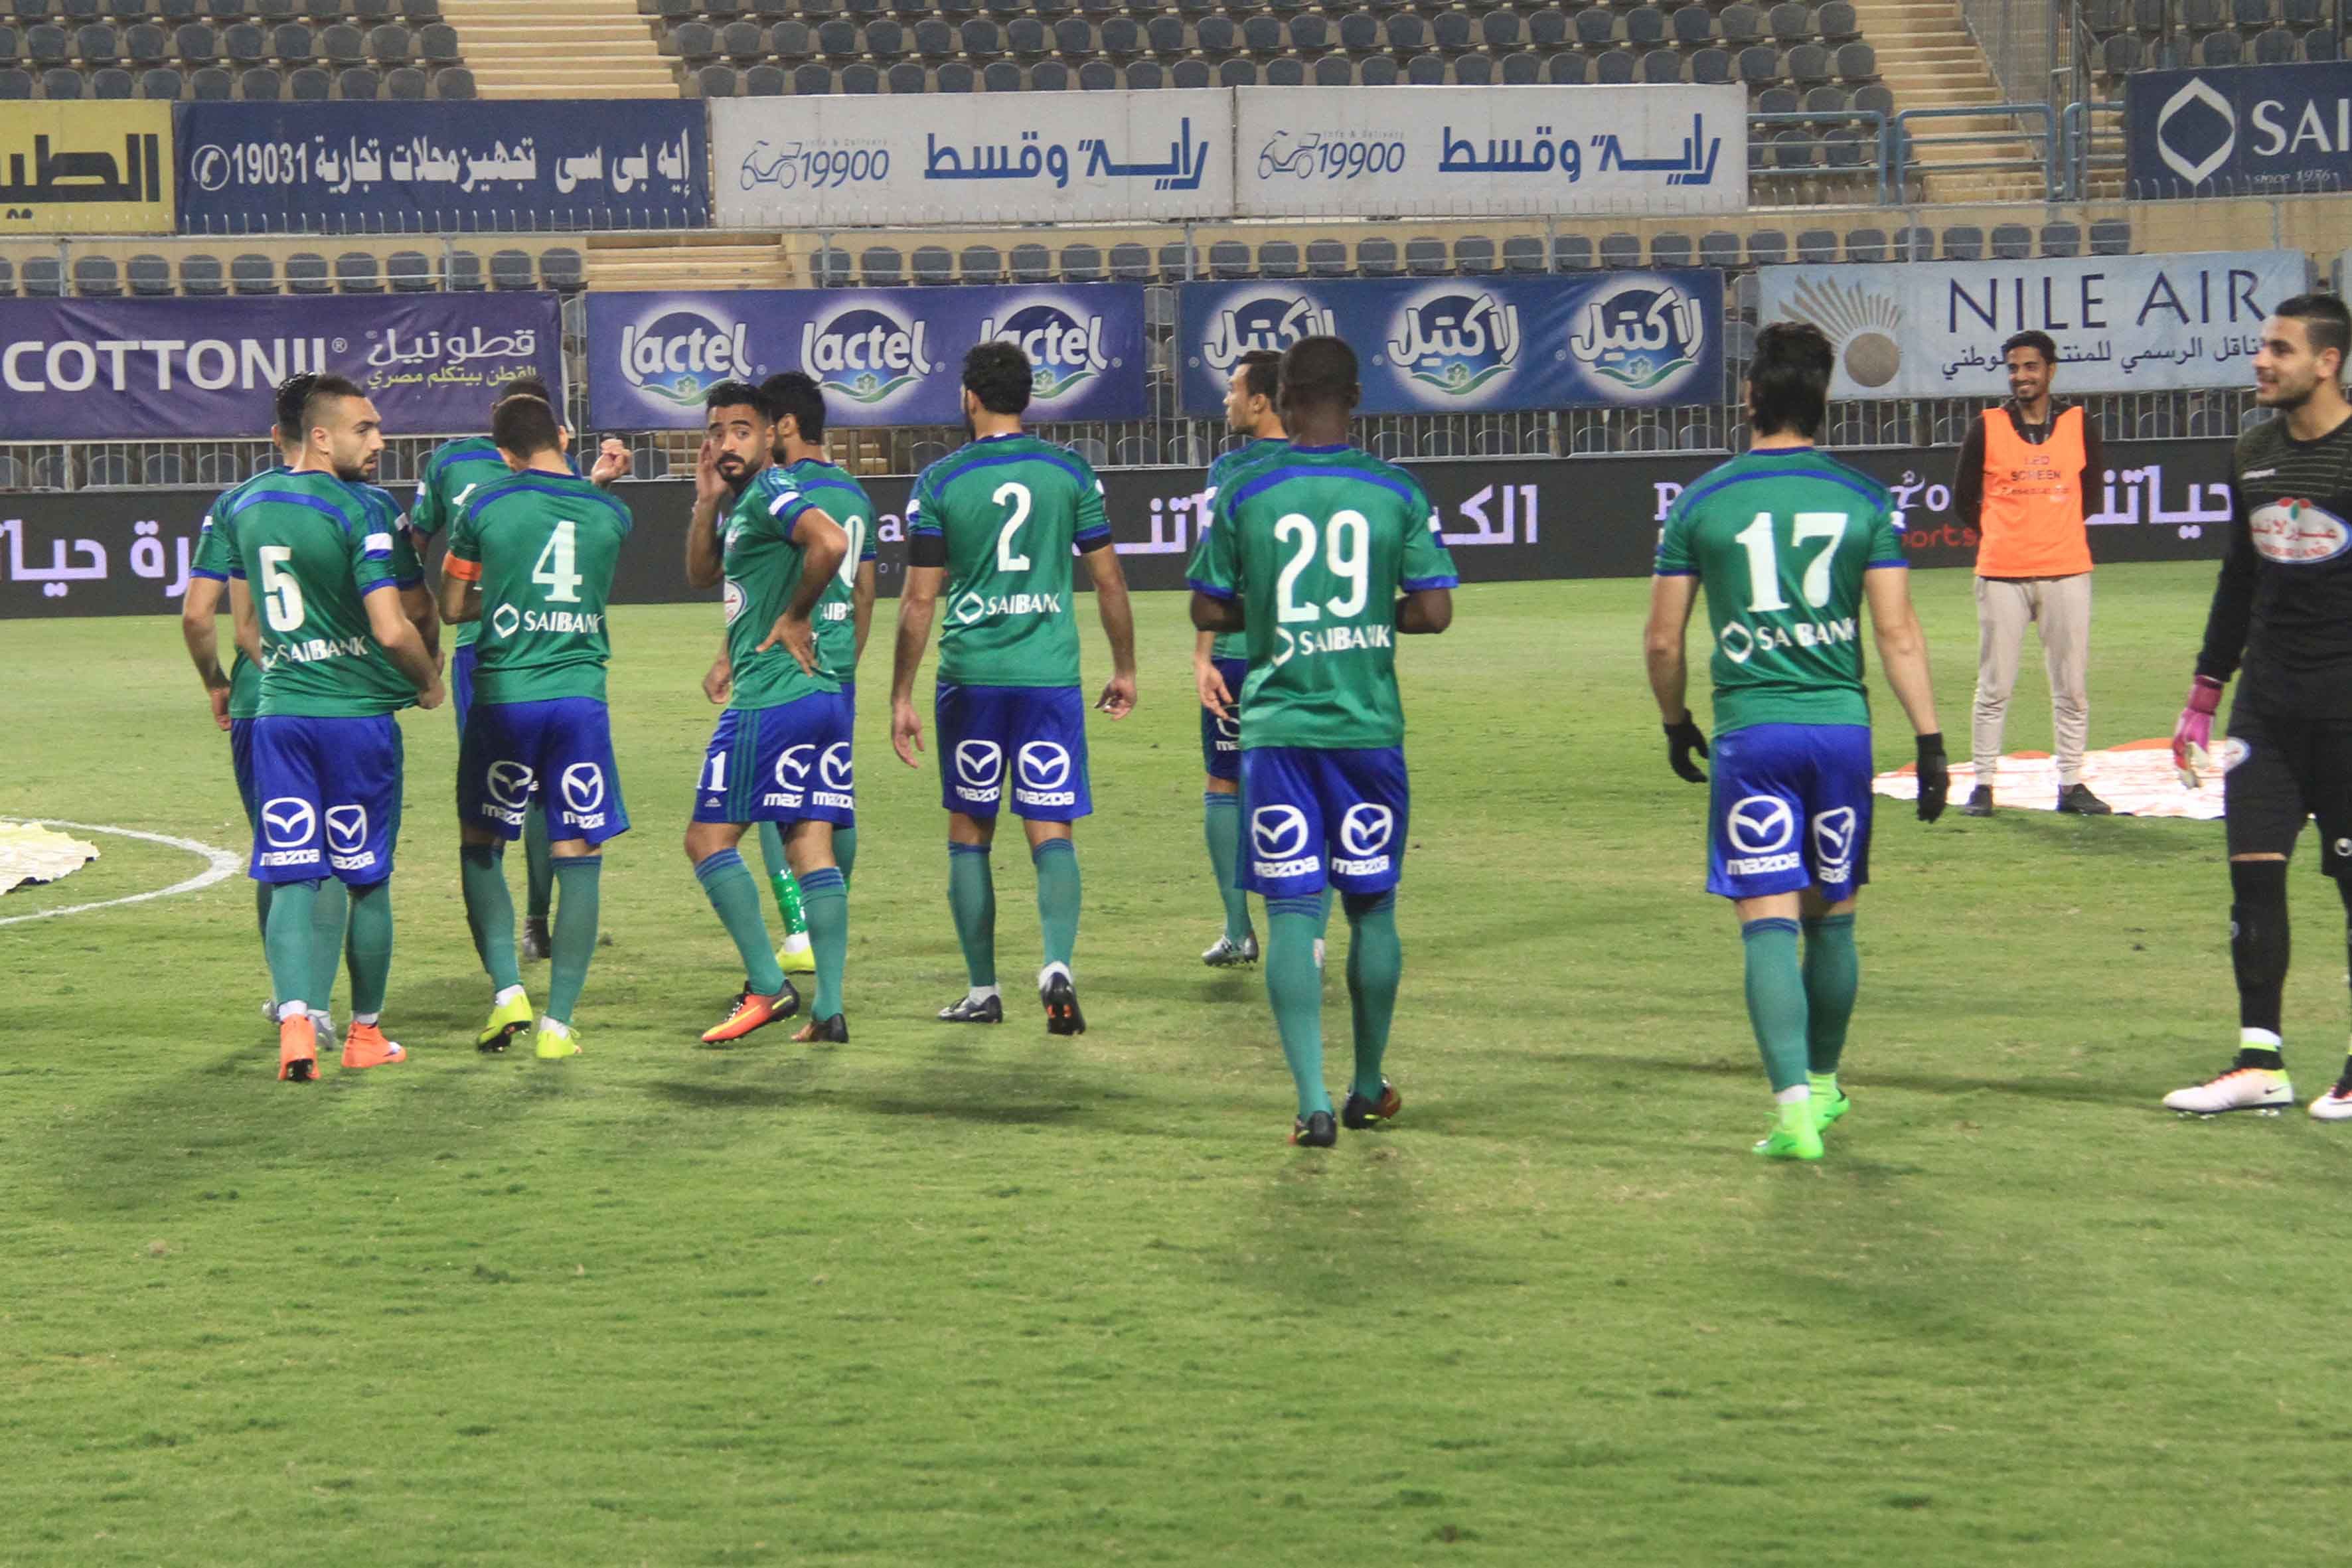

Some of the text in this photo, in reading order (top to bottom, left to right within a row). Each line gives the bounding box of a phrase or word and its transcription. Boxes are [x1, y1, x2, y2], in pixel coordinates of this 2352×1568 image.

[1438, 125, 1581, 182] وقسط
[2252, 98, 2351, 156] SAI
[0, 133, 160, 219] الطي
[232, 141, 309, 185] 19031
[315, 135, 382, 194] تجارية
[388, 135, 461, 183] محلات
[461, 137, 536, 193] تجهيز
[801, 149, 890, 188] 19900
[924, 131, 1069, 188] وقسط
[1318, 141, 1405, 179] 19900
[1570, 287, 1703, 362] لاكتيل
[1948, 270, 2266, 333] NILE AIR
[366, 327, 535, 366] قطونيل
[620, 322, 753, 387] lactel
[801, 320, 931, 384] lactel
[1387, 293, 1520, 367] لاكتيل
[2057, 340, 2111, 363] للمنت
[2121, 337, 2203, 374] الرسمي
[1942, 343, 2007, 380] لوطني
[992, 481, 1032, 572] 2
[1441, 484, 1538, 545] الك
[2084, 465, 2233, 539] حياتن
[0, 518, 108, 597] حيا
[532, 520, 583, 603] 4
[1274, 509, 1370, 623] 29
[1734, 511, 1849, 613] 17
[258, 545, 305, 632] 5
[985, 592, 1062, 616] SAIBANK
[277, 635, 368, 664] SAIBANK
[1299, 624, 1391, 657] SAIBANK
[1756, 617, 1857, 651] SABAN
[481, 803, 526, 826] mazd
[956, 785, 1000, 803] mazd
[1016, 788, 1075, 807] mazda
[260, 848, 320, 867] mazda
[330, 850, 376, 870] azda
[1727, 851, 1800, 876] mazda
